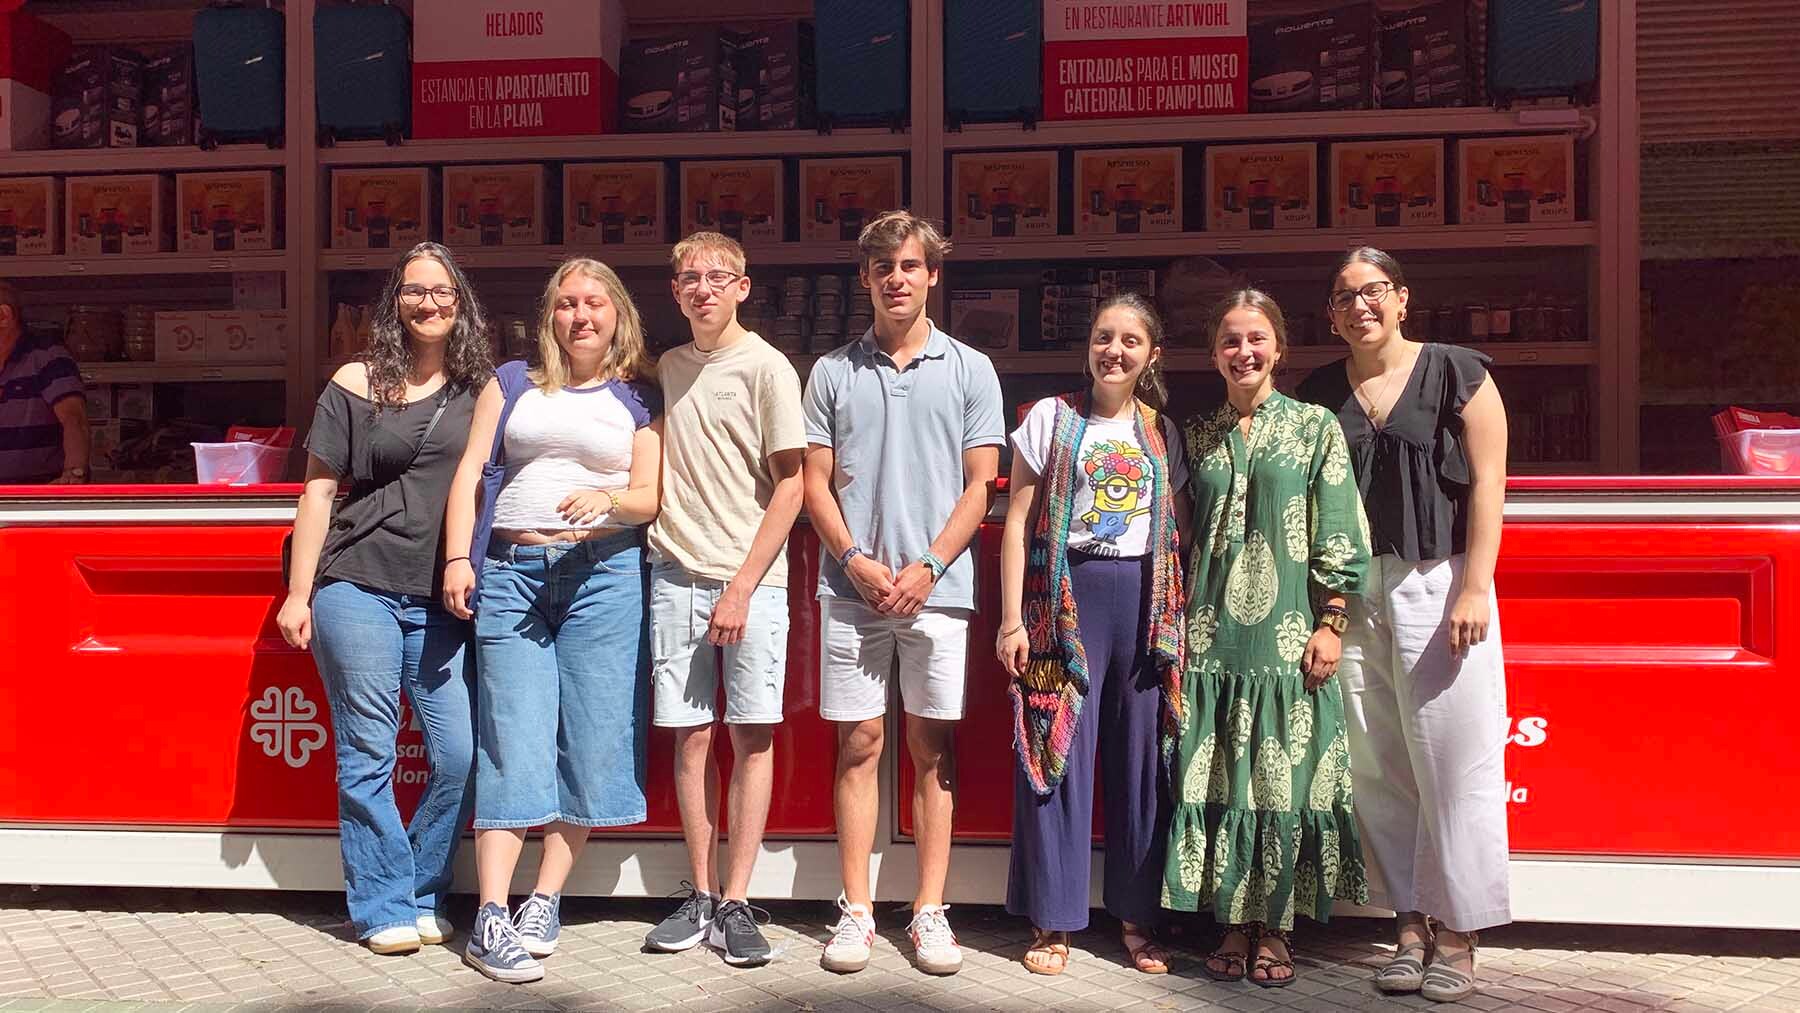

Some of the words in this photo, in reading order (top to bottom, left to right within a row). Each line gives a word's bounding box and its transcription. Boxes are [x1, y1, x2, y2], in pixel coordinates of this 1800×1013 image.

[486, 12, 544, 36] HELADOS
[1065, 7, 1080, 30] EN
[1084, 5, 1164, 30] RESTAURANTE
[1166, 3, 1230, 27] ARTWOHL
[1059, 57, 1133, 85] ENTRADAS
[1137, 56, 1169, 82] PARA
[1172, 56, 1185, 81] EL
[1189, 53, 1239, 80] MUSEO
[421, 75, 476, 104] ESTANCIA
[479, 79, 495, 101] EN
[495, 72, 590, 101] APARTAMENTO
[1064, 87, 1135, 114] CATEDRAL
[1138, 86, 1153, 111] DE
[1156, 83, 1235, 111] PAMPLONA
[469, 106, 484, 129] EN
[486, 105, 501, 128] LA
[503, 103, 544, 128] PLAYA
